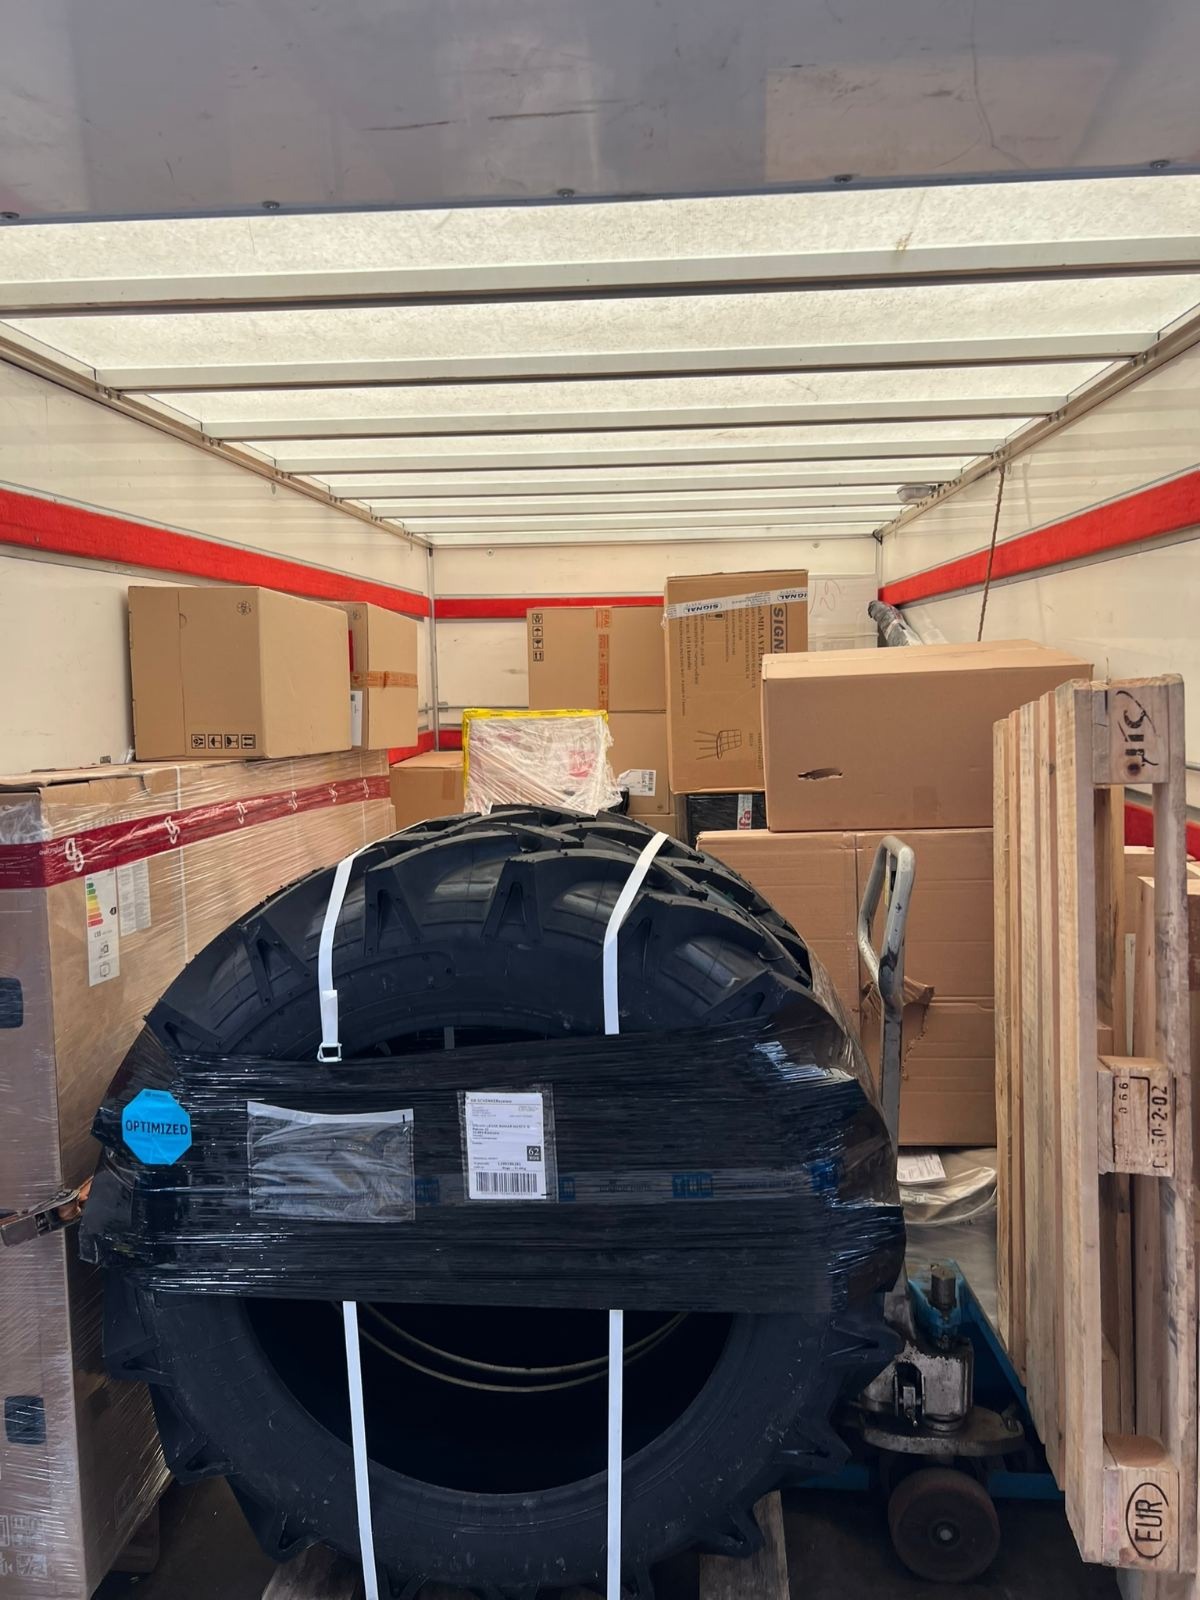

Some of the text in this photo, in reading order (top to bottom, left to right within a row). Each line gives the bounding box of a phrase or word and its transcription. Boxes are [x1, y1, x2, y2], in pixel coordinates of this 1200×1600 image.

[773, 607, 785, 653] SIGN
[125, 1119, 189, 1136] OPTIMIZED
[528, 1147, 540, 1156] 62
[1135, 1499, 1163, 1542] EUR
